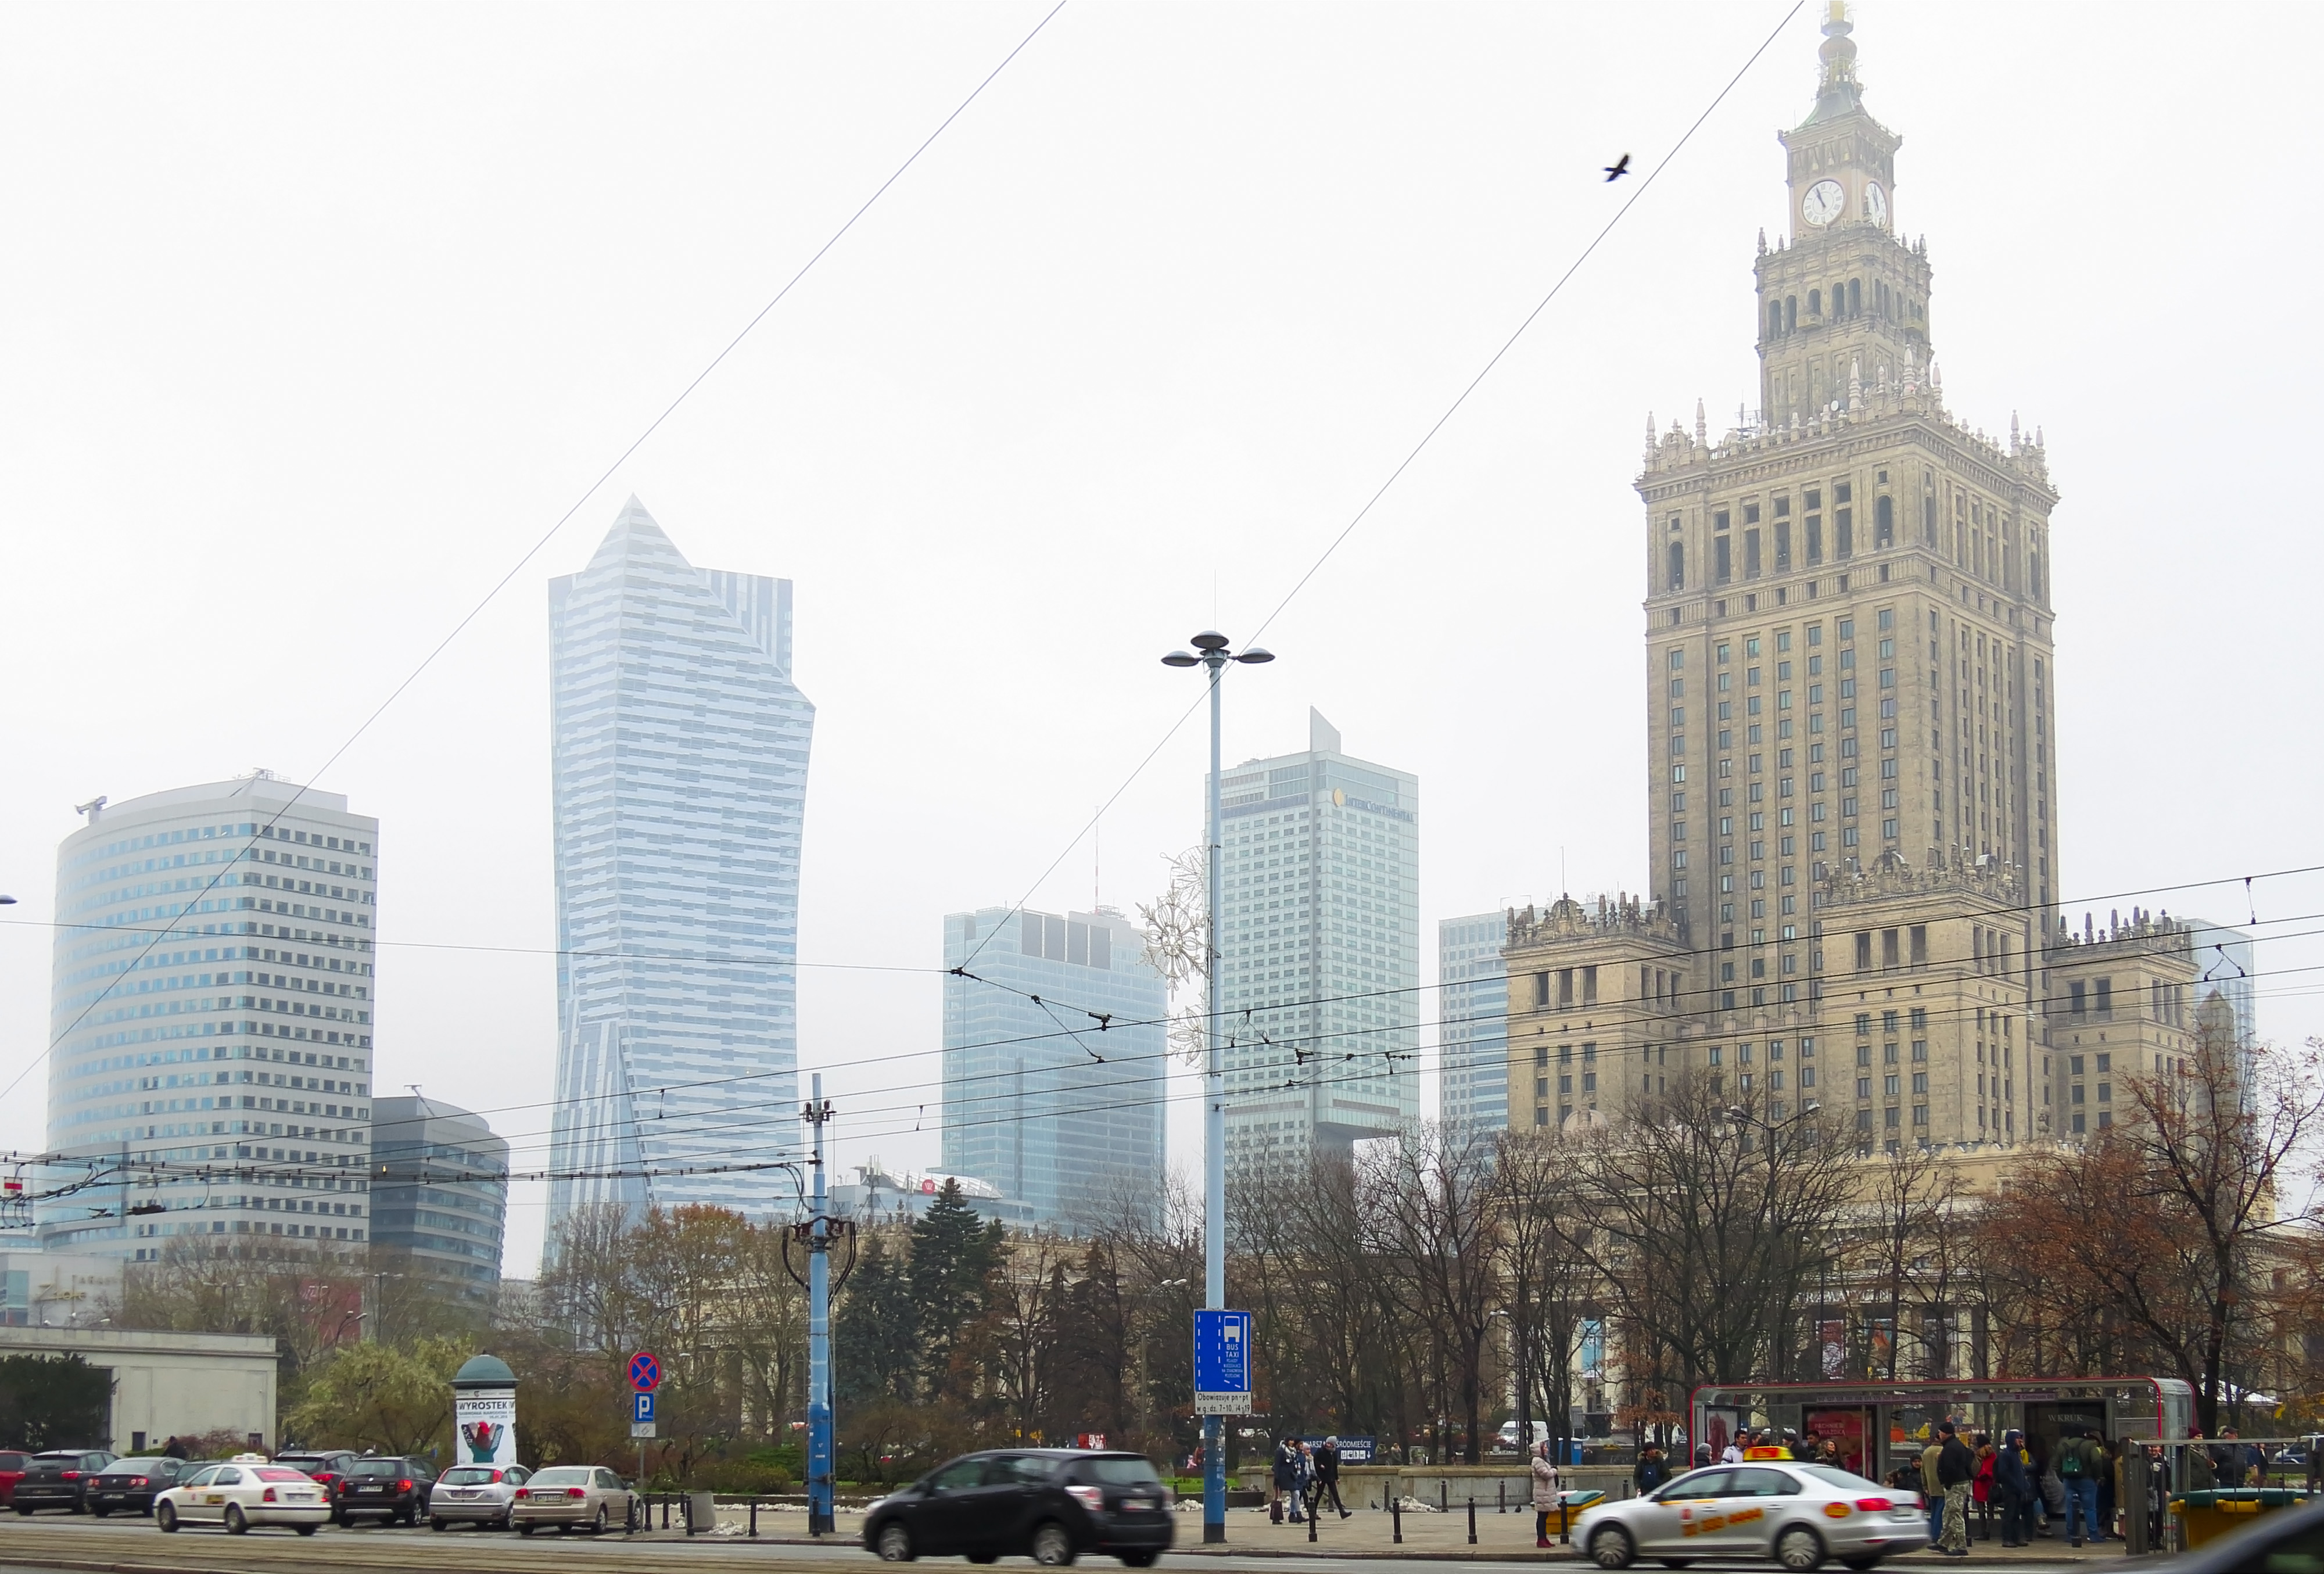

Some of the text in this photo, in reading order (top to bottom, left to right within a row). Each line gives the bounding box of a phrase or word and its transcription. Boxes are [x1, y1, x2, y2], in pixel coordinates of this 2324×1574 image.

[1197, 1393, 1229, 1402] Obowiązuje
[458, 1401, 507, 1410] WYROSTEK
[639, 1396, 650, 1419] P
[1336, 1439, 1371, 1448] ŚRÓDMIEŚCIE
